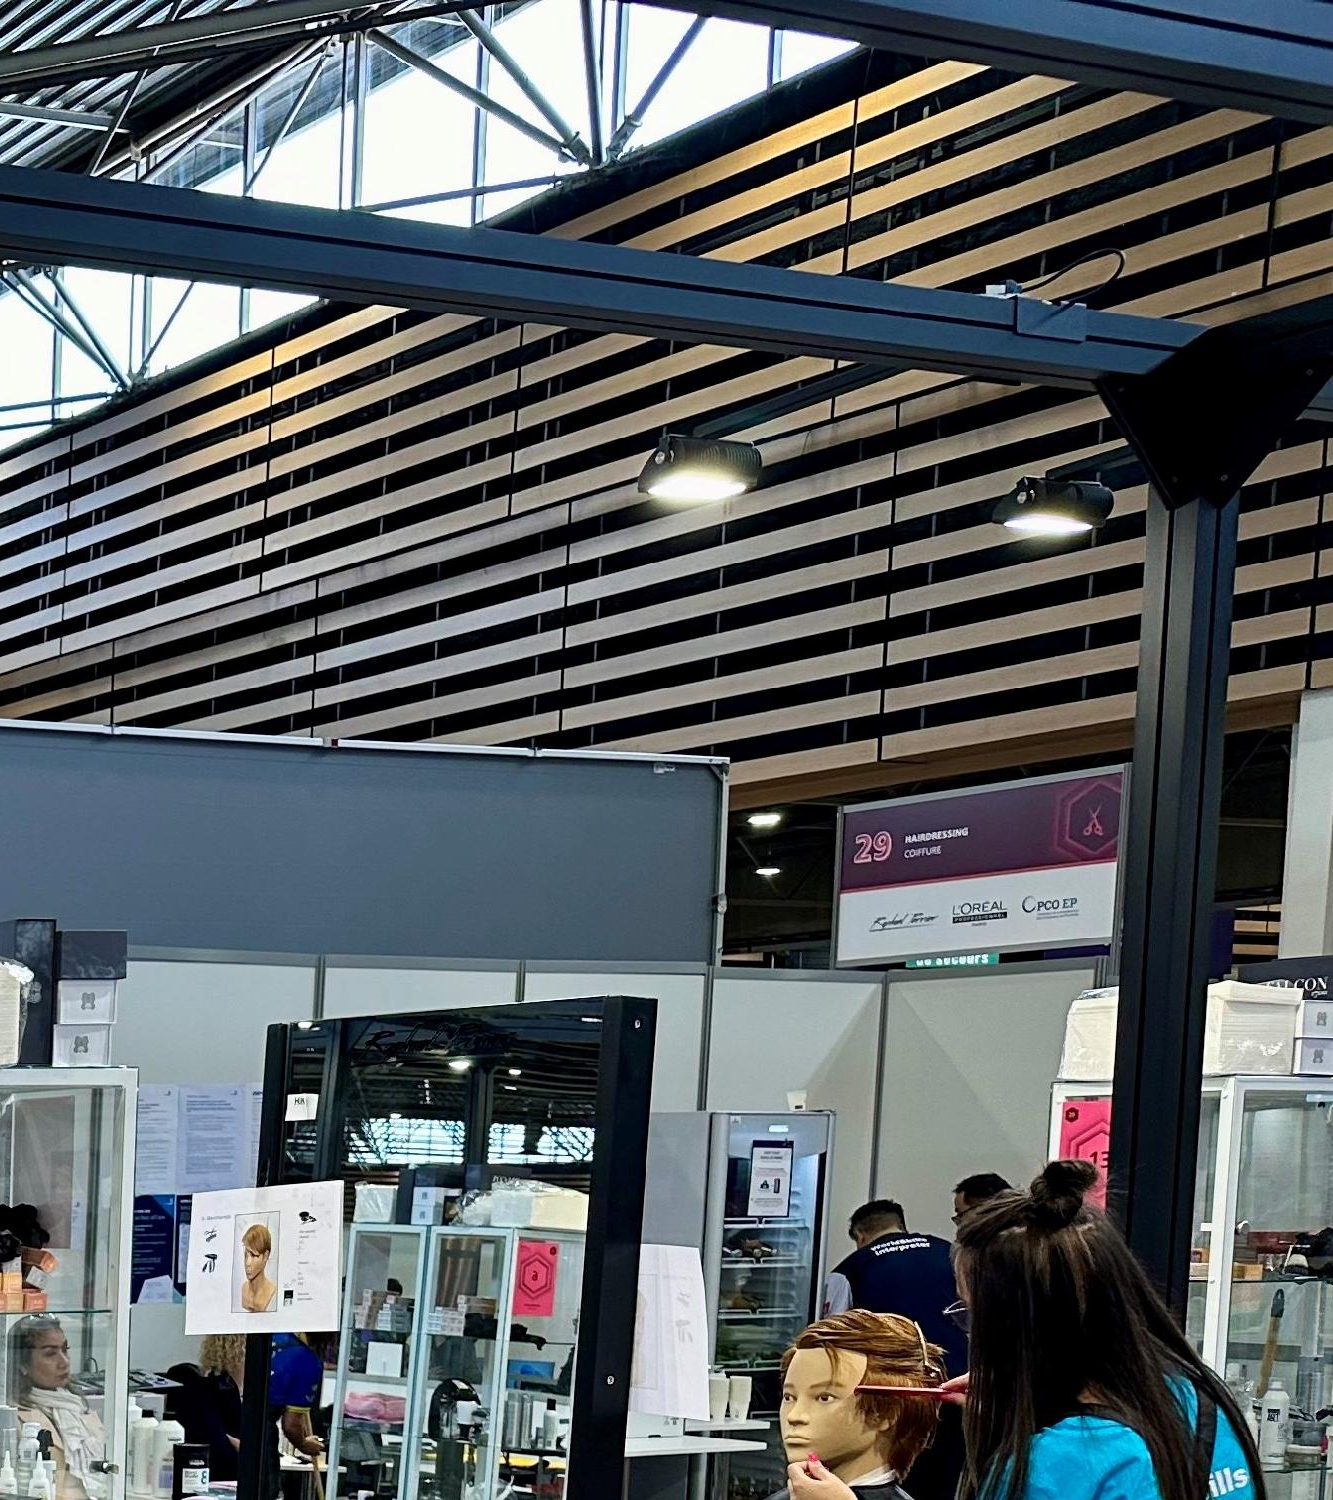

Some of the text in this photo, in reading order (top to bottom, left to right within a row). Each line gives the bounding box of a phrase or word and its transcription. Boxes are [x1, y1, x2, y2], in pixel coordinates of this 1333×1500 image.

[853, 827, 969, 865] 29 HAIRDRESSING
[904, 845, 942, 860] COIFFURE
[1062, 897, 1078, 909] EP
[201, 1470, 208, 1485] 8
